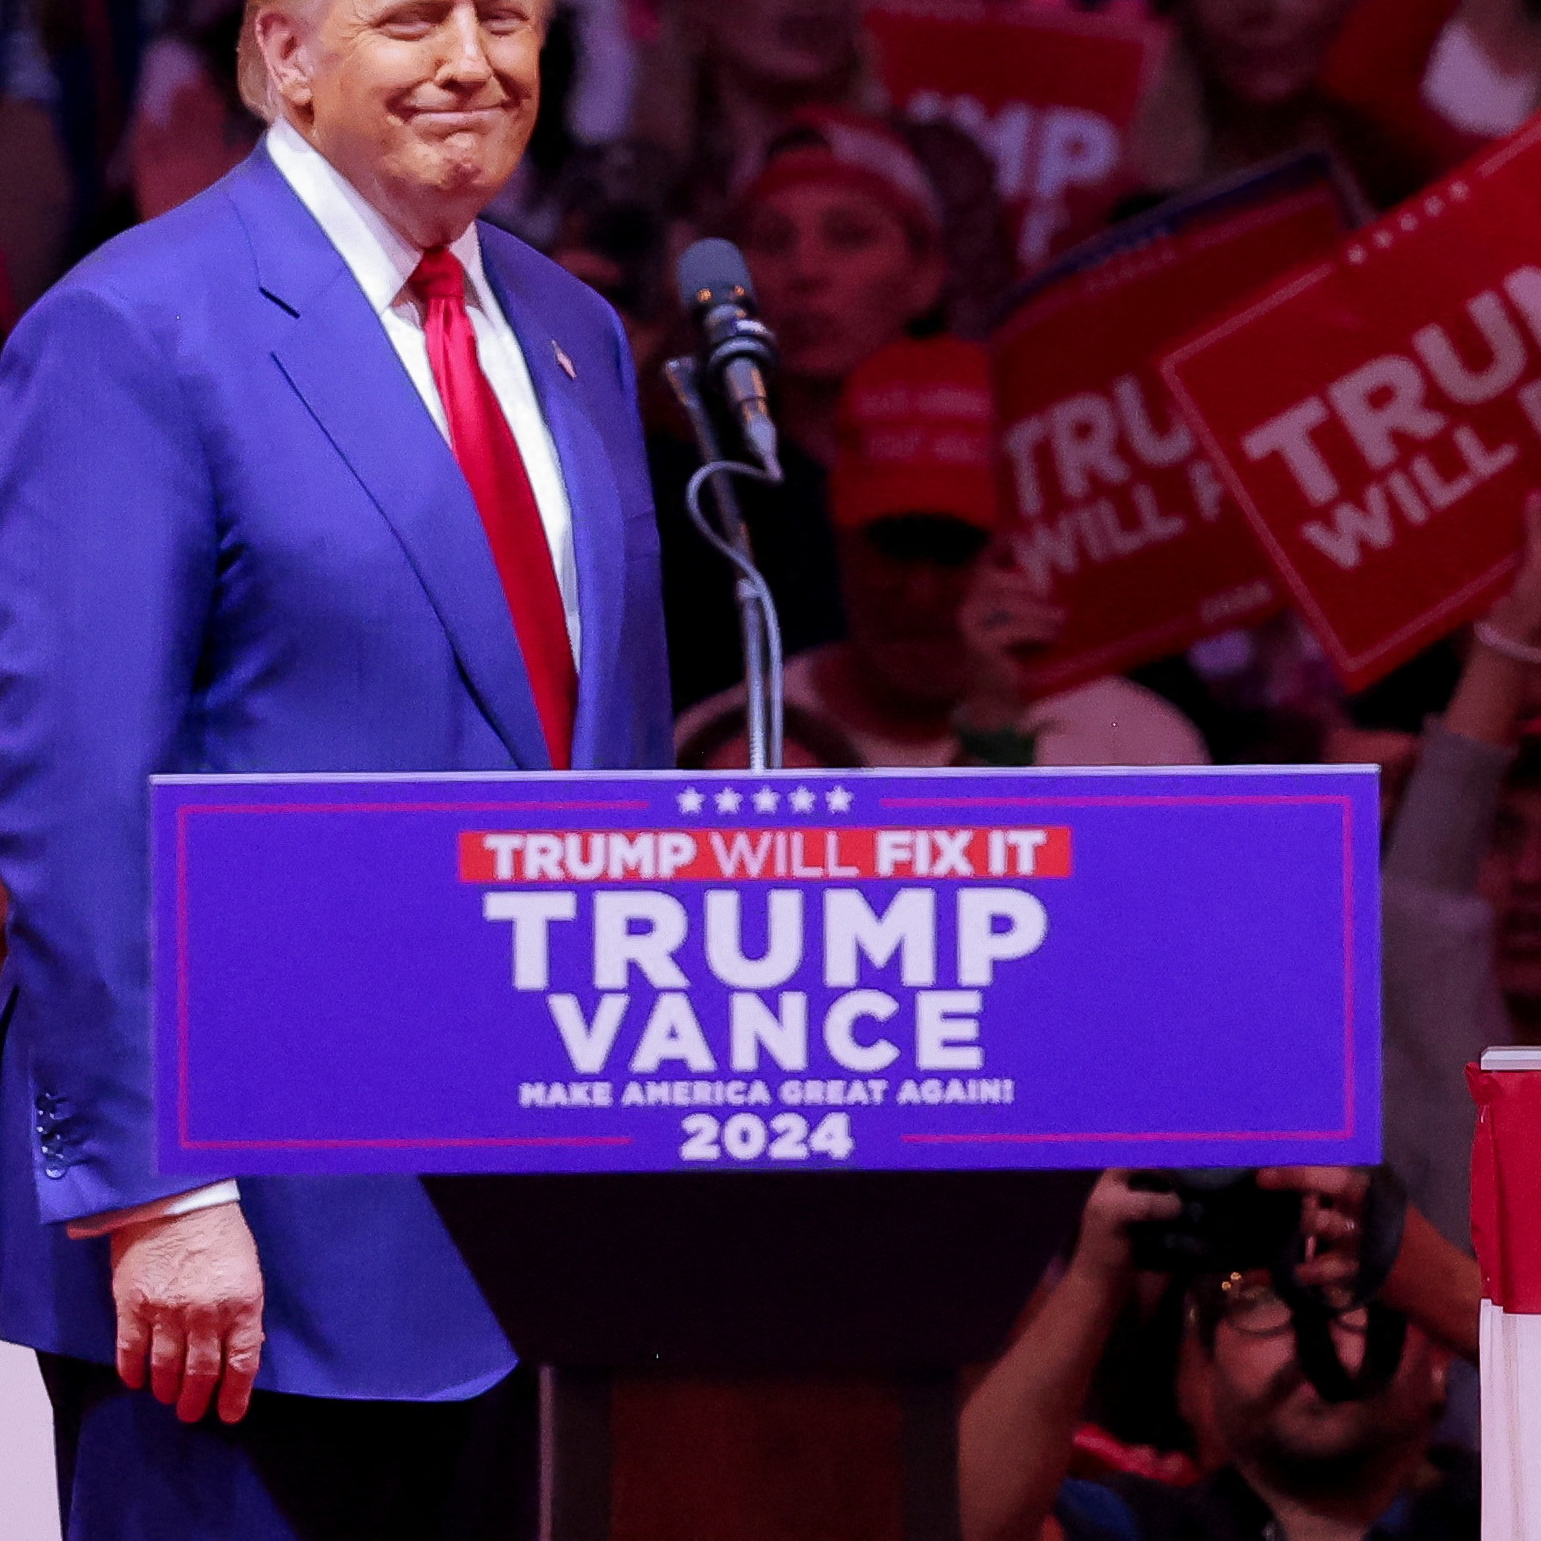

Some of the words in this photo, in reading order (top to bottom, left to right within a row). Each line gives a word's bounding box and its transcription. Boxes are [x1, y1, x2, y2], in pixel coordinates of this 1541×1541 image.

[1003, 373, 1196, 519] TRU
[1011, 482, 1187, 597] WILL
[1300, 421, 1521, 571] WILL
[482, 830, 699, 881] TRUMP
[709, 829, 860, 879] WILL
[874, 828, 976, 877] FIX
[986, 828, 1048, 877] IT
[482, 887, 1050, 991] TRUMP
[545, 988, 986, 1074] VANCE
[517, 1080, 614, 1109] MAKE
[621, 1078, 773, 1107] AMERICA
[778, 1078, 890, 1107] GREAT
[895, 1077, 1016, 1106] AGAIN!
[678, 1110, 856, 1161] 2024
